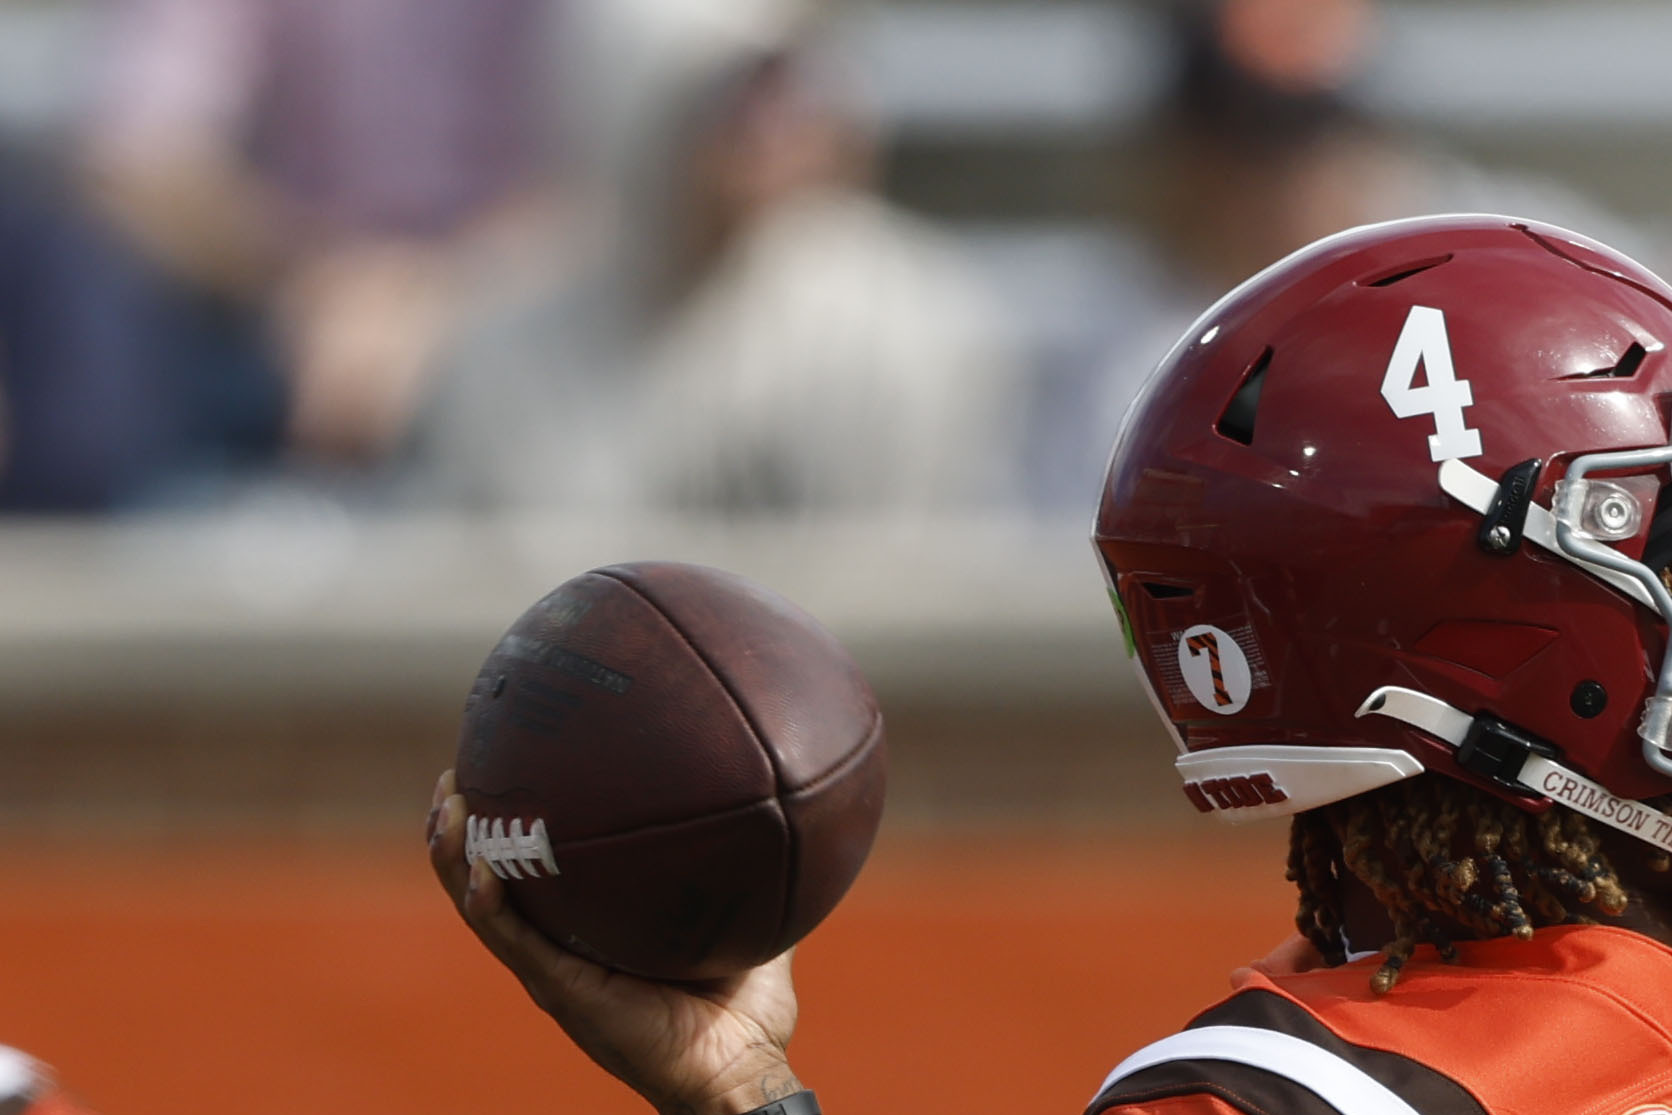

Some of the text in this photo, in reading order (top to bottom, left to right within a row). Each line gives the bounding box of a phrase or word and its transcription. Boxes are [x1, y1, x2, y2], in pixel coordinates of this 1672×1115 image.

[1380, 304, 1483, 462] 4
[1185, 631, 1234, 707] 7
[1201, 772, 1289, 810] TIDE
[1542, 770, 1650, 832] CRIMSON
